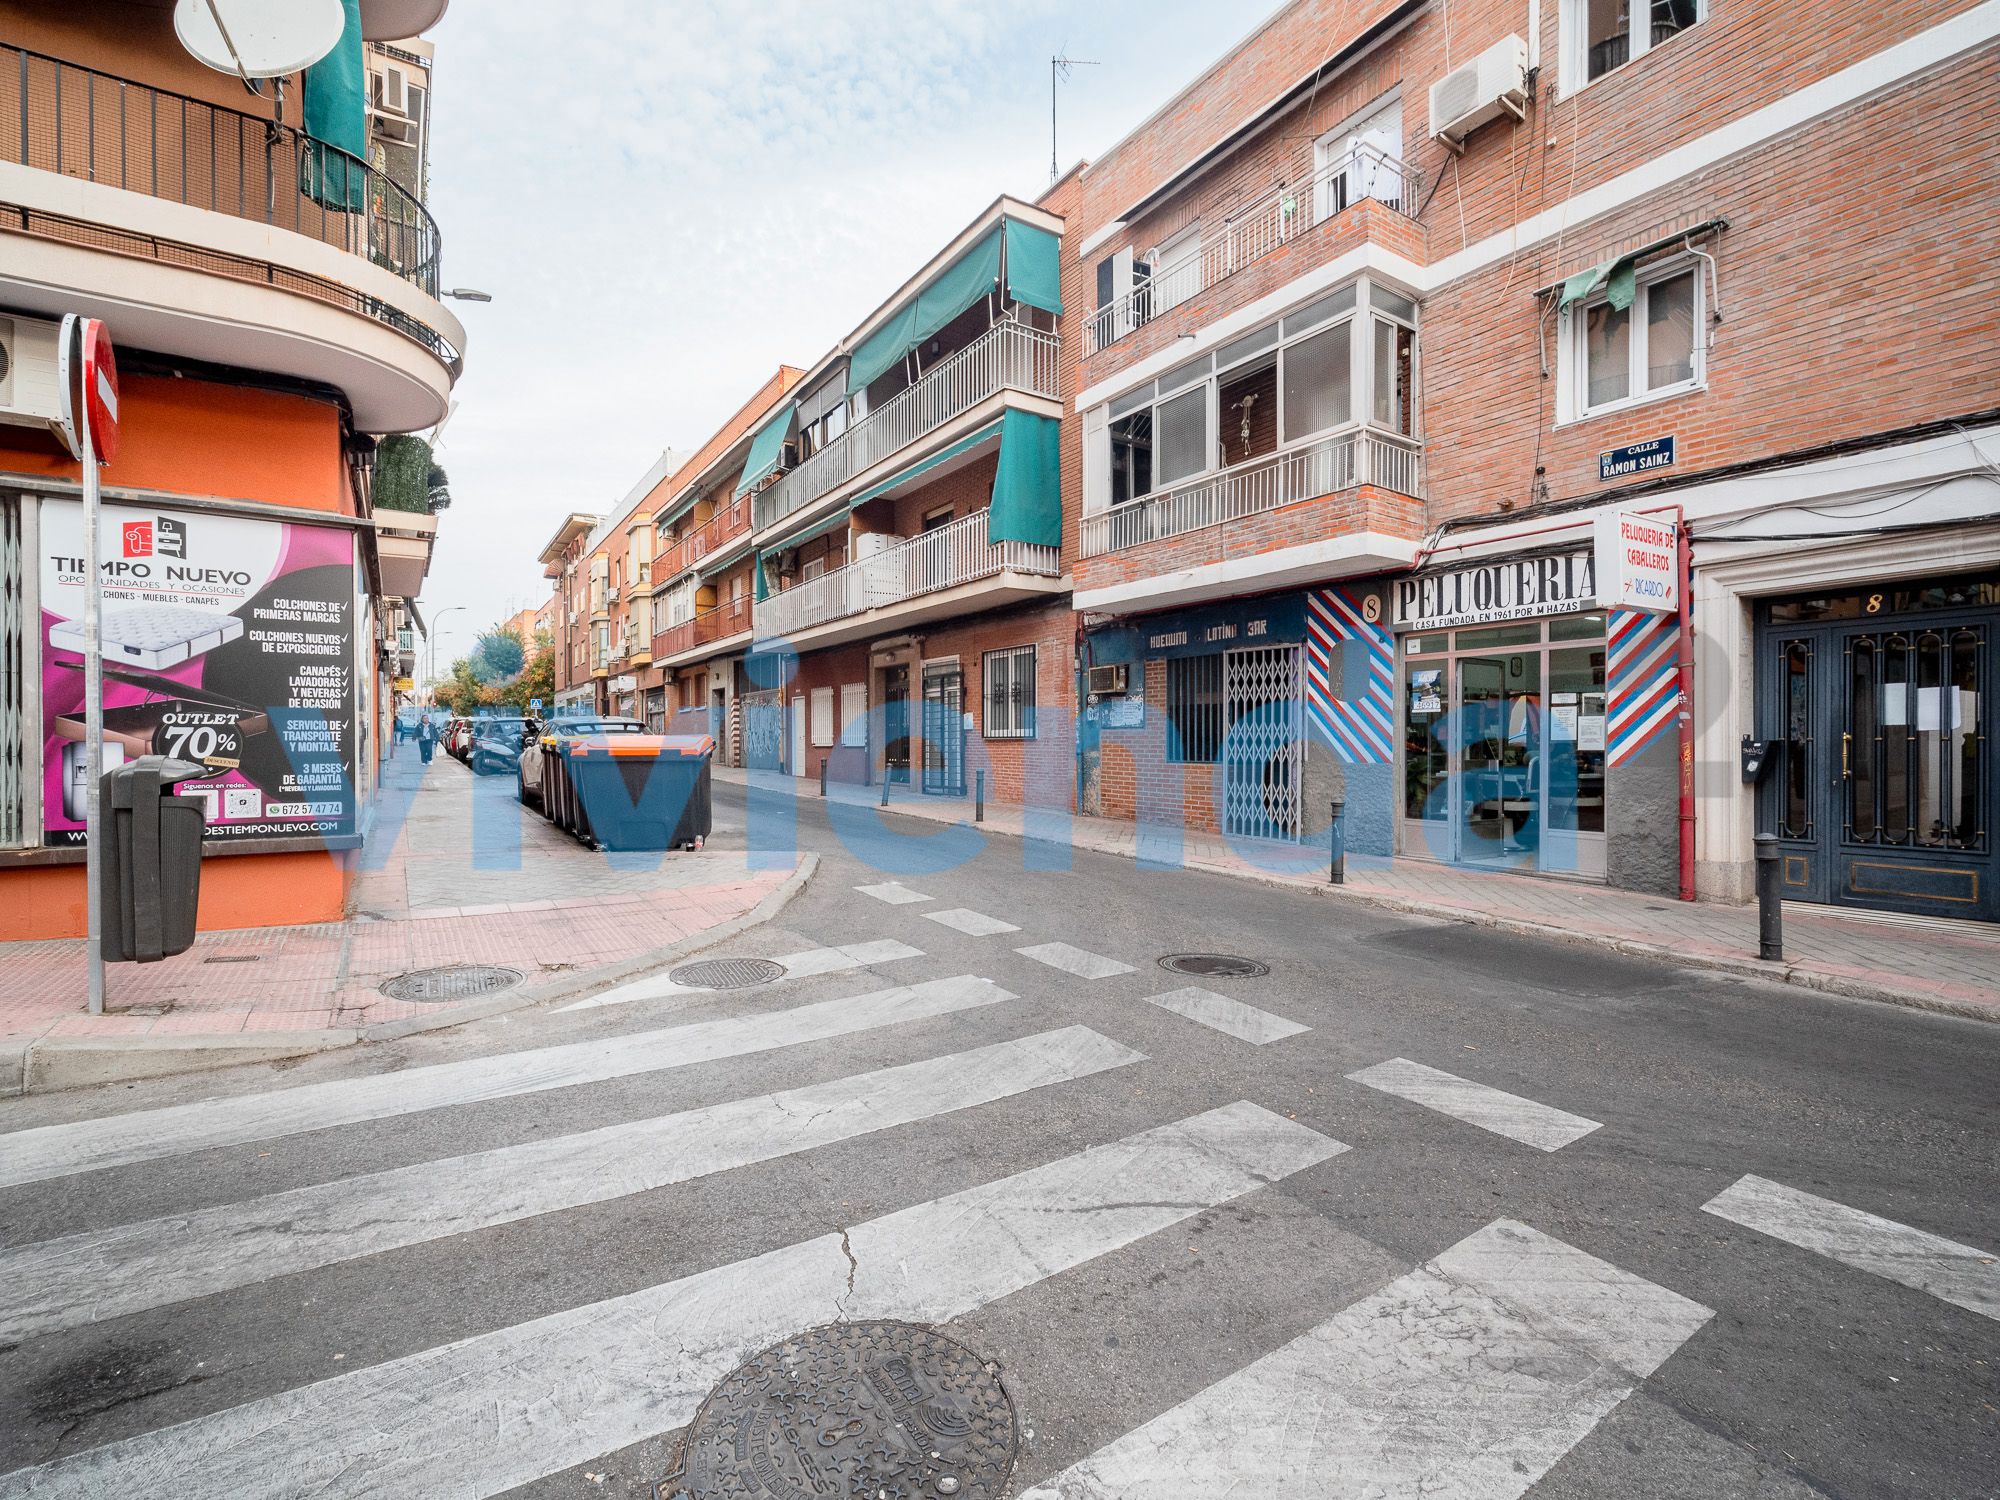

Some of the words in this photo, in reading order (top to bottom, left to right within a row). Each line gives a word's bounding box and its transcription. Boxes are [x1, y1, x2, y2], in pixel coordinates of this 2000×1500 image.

[1627, 442, 1660, 455] CALLE
[1603, 458, 1637, 478] RAMON
[1639, 452, 1670, 471] SAINZ
[1620, 521, 1664, 547] PELUQUERIA
[1665, 532, 1674, 549] DE
[1627, 548, 1670, 571] CABALLEROS
[51, 556, 151, 578] TIEMPO
[166, 566, 252, 586] NUEVO
[58, 574, 160, 590] OPOUNIDADES
[169, 582, 176, 590] Y
[182, 584, 246, 595] OCASIONES
[1398, 550, 1596, 622] PELUQUERIA
[1635, 578, 1664, 598] RICARDO
[101, 590, 136, 600] CHONES
[142, 593, 178, 603] MUEBLES
[1866, 594, 1884, 613] 8
[274, 598, 327, 612] COLCHONES
[328, 603, 341, 613] DE
[1366, 598, 1377, 619] 8
[254, 608, 302, 622] PRIMERAS
[303, 612, 341, 624] MARCAS
[1415, 616, 1436, 630] CASA
[1438, 614, 1476, 628] FUNDADA
[1479, 612, 1492, 622] EN
[1493, 610, 1513, 621] 1961
[1515, 607, 1533, 618] POR
[1546, 602, 1578, 613] HAZAS
[249, 630, 304, 644] COLCHONES
[305, 633, 341, 645] NUEVOS
[262, 642, 275, 653] DE
[276, 643, 341, 656] EXPOSICIONES
[300, 665, 341, 677] CANAPÉS
[289, 676, 341, 688] LAVADORAS
[292, 687, 299, 698] Y
[300, 688, 341, 698] NEVERAS
[288, 698, 300, 708] DE
[302, 697, 341, 710] OCASIÓN
[162, 712, 240, 725] OUTLET
[286, 720, 328, 730] SERVICIO
[329, 720, 342, 730] DE
[164, 726, 237, 759] 70%
[282, 730, 342, 742] TRANSPORTE
[289, 742, 296, 752] Y
[298, 742, 342, 752] MONTAJE.
[303, 764, 310, 774] 3
[311, 764, 342, 774] MESES
[282, 774, 296, 785] DE
[297, 772, 342, 784] GARANTÍA
[282, 805, 300, 814] 672
[302, 804, 313, 814] 57
[316, 804, 327, 814] 47
[329, 804, 340, 813] 74
[882, 1357, 935, 1406] Canal
